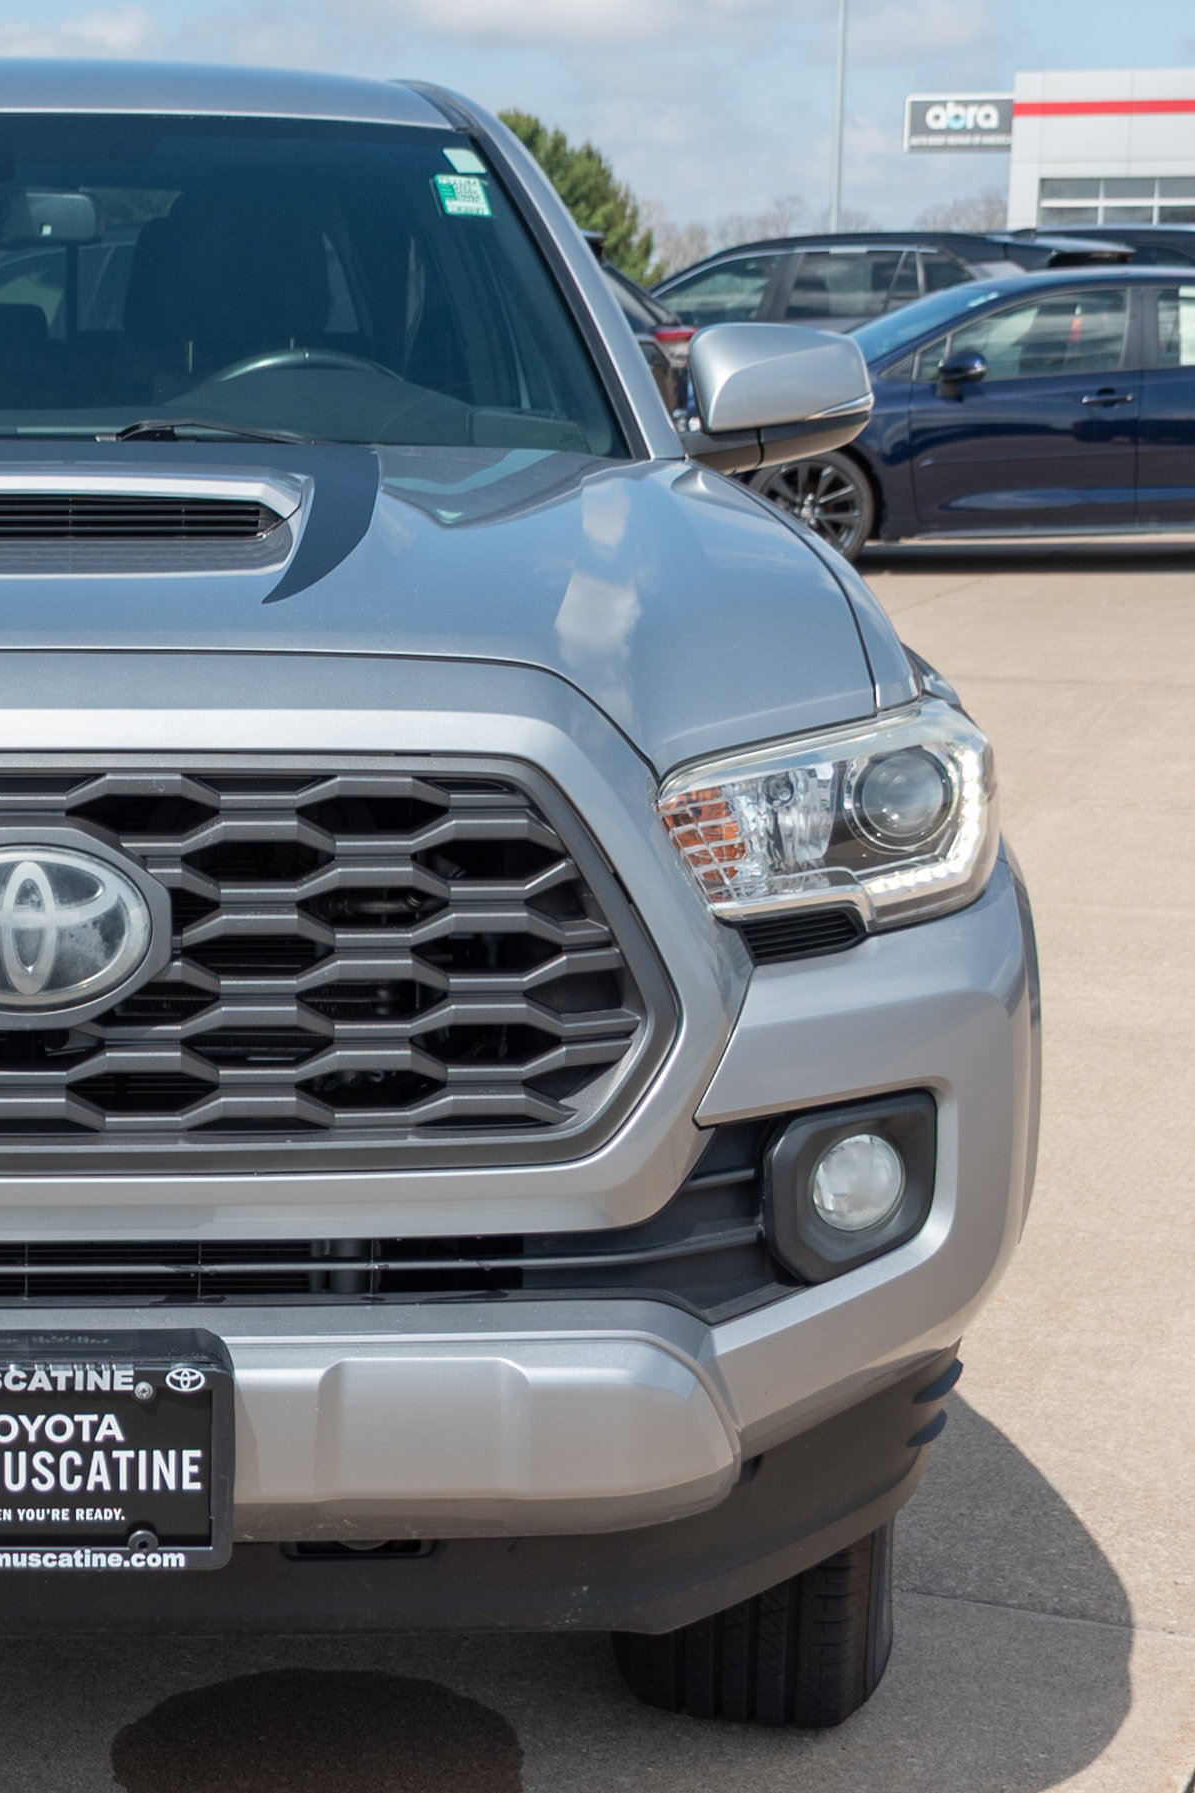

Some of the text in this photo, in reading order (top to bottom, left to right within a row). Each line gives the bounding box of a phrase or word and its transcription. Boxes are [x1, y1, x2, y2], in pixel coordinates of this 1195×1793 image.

[925, 101, 999, 130] abra
[17, 1508, 70, 1522] YOU'RE
[75, 1508, 126, 1522] READY.
